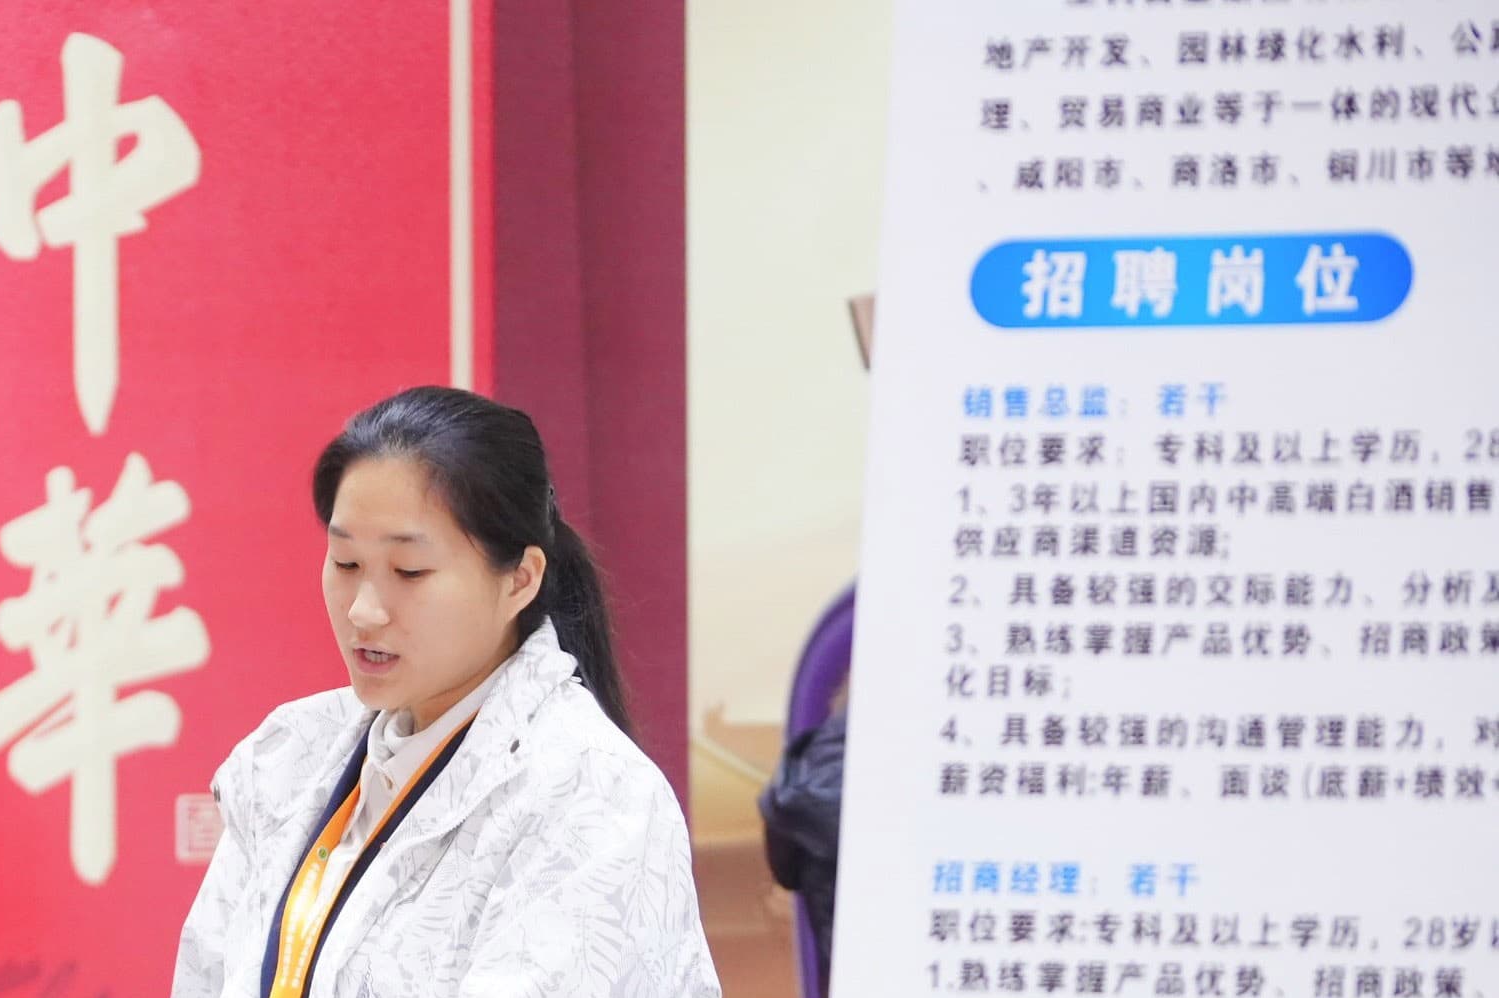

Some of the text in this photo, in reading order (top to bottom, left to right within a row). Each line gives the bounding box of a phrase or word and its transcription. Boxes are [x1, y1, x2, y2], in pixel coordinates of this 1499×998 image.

[983, 19, 1499, 72] 地产开发、园林绿化水利、公
[1020, 243, 1360, 319] 招聘岗位
[961, 382, 1226, 421] 销售总监：若干
[957, 476, 1495, 517] 1、3年以上国内中高端白酒销售
[952, 523, 1230, 560] 供应商渠道资源;
[945, 664, 1069, 700] 化目标；
[932, 859, 1199, 899] 招商经理：若干
[928, 909, 1499, 952] 职位要求:专科及以上学历，28岁
